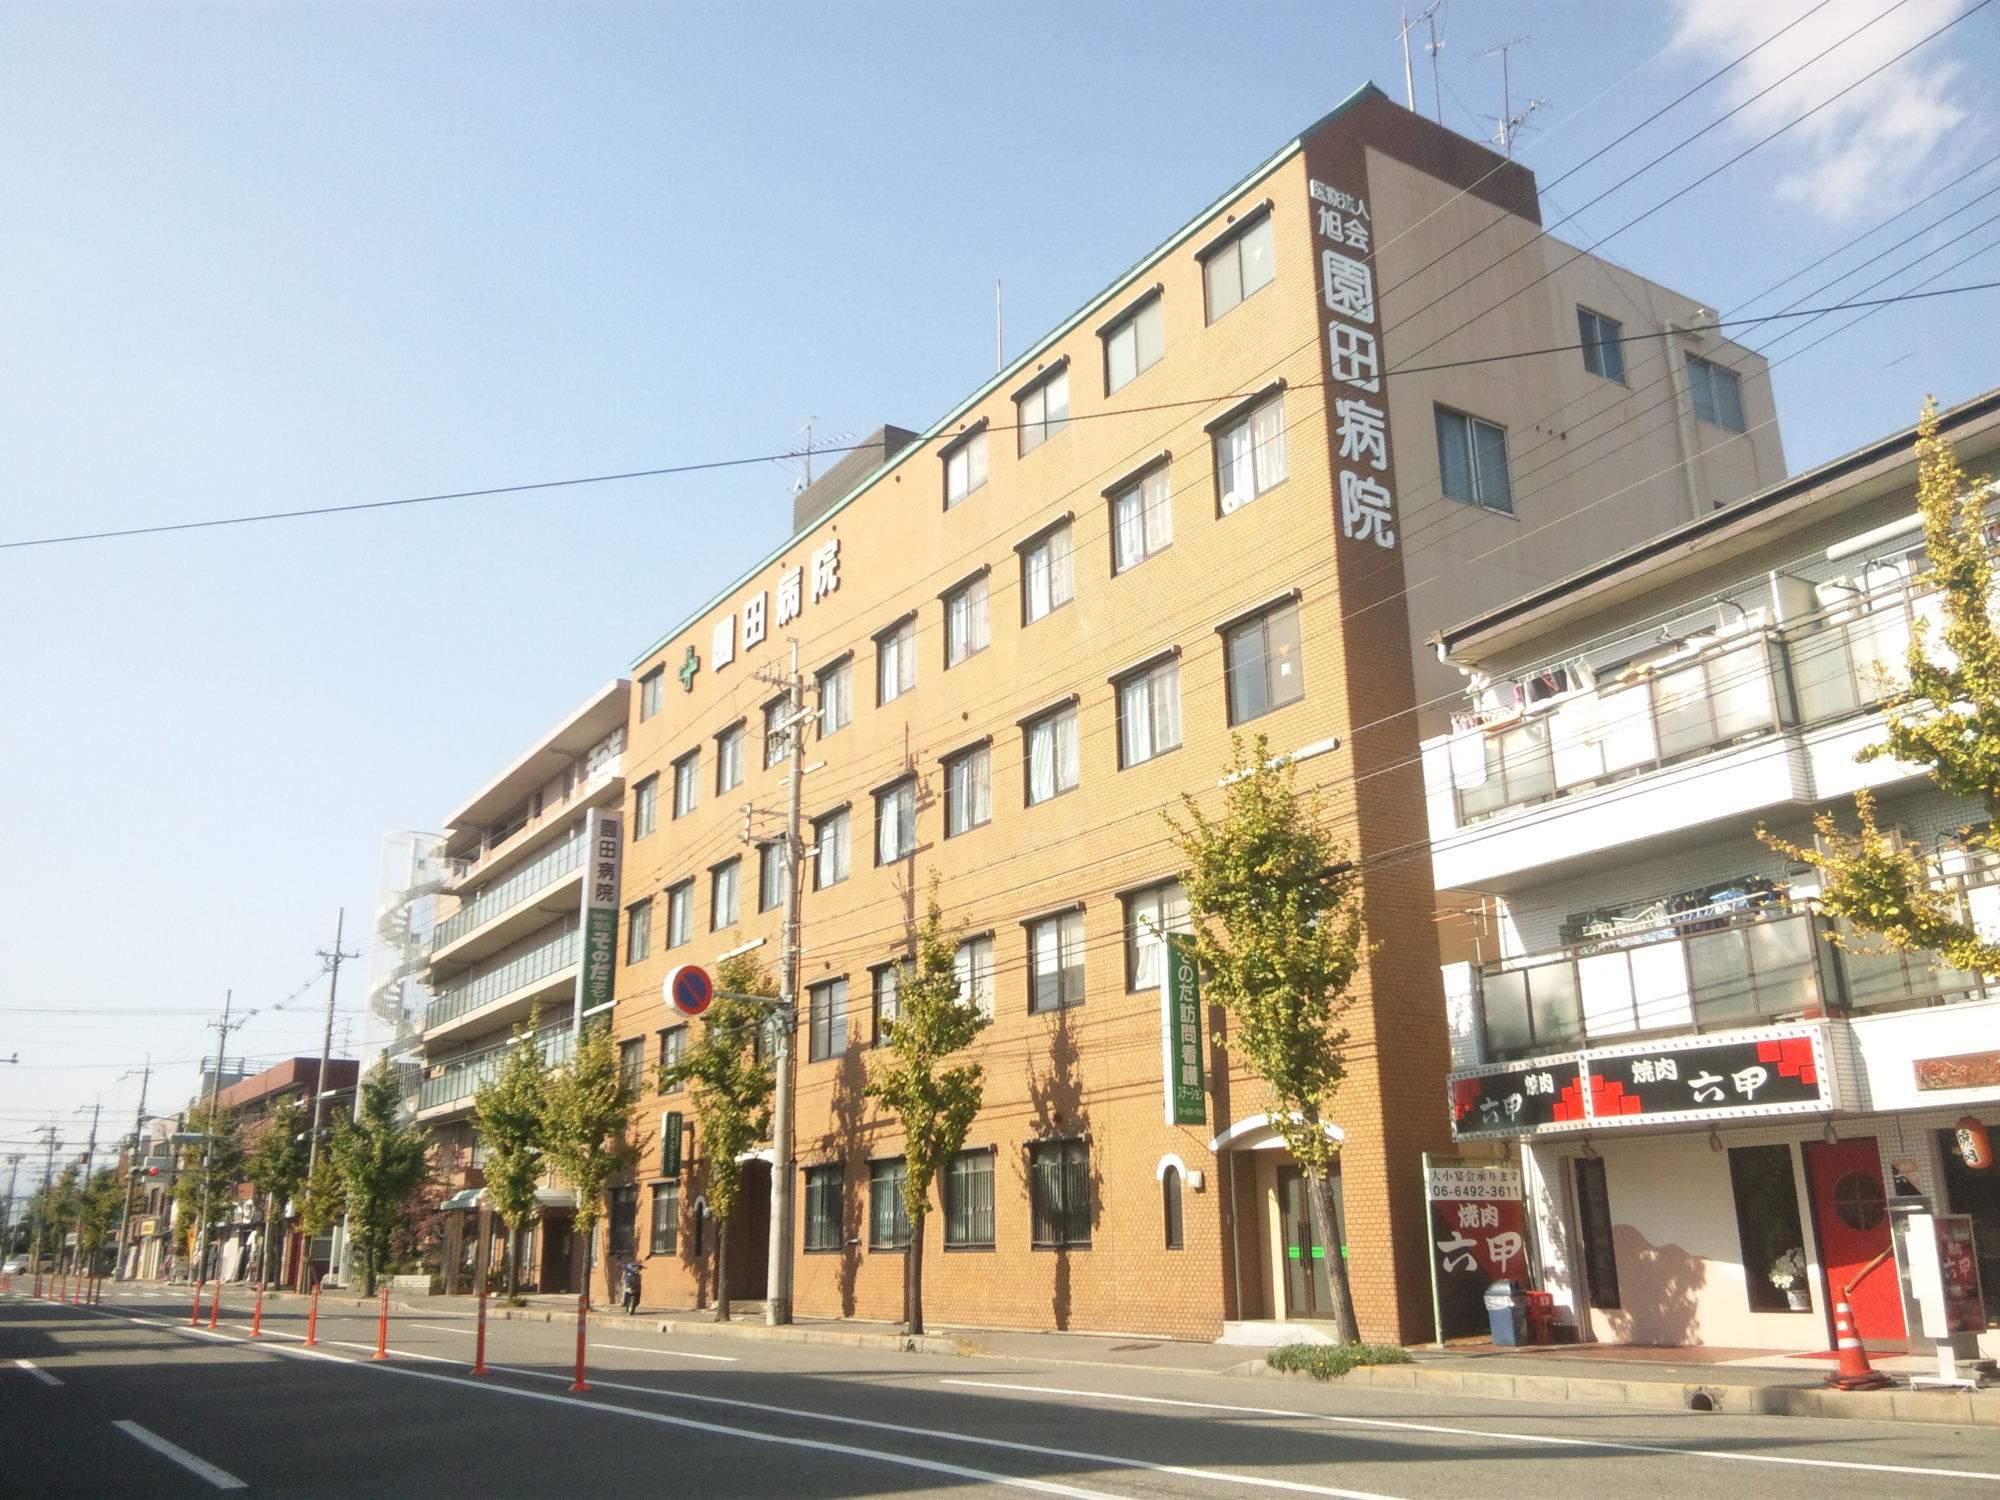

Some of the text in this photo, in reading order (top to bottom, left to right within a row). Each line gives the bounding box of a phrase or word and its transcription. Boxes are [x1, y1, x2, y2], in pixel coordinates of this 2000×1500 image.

[1317, 205, 1369, 253] 旭会
[1321, 249, 1395, 549] 園田病院
[595, 819, 618, 902] 園田病院
[1524, 1071, 1554, 1096] 焼肉
[1630, 1057, 1678, 1084] 焼肉
[1687, 1066, 1767, 1102] 六甲
[1177, 1086, 1204, 1101] ステーション
[1479, 1092, 1523, 1124] 六甲
[1431, 1169, 1519, 1182] 大小宴会承ります
[1433, 1185, 1519, 1198] 06-6492-3611
[1457, 1203, 1500, 1228] 焼肉
[1436, 1230, 1522, 1274] 六甲
[1943, 1257, 1970, 1279] 六甲
